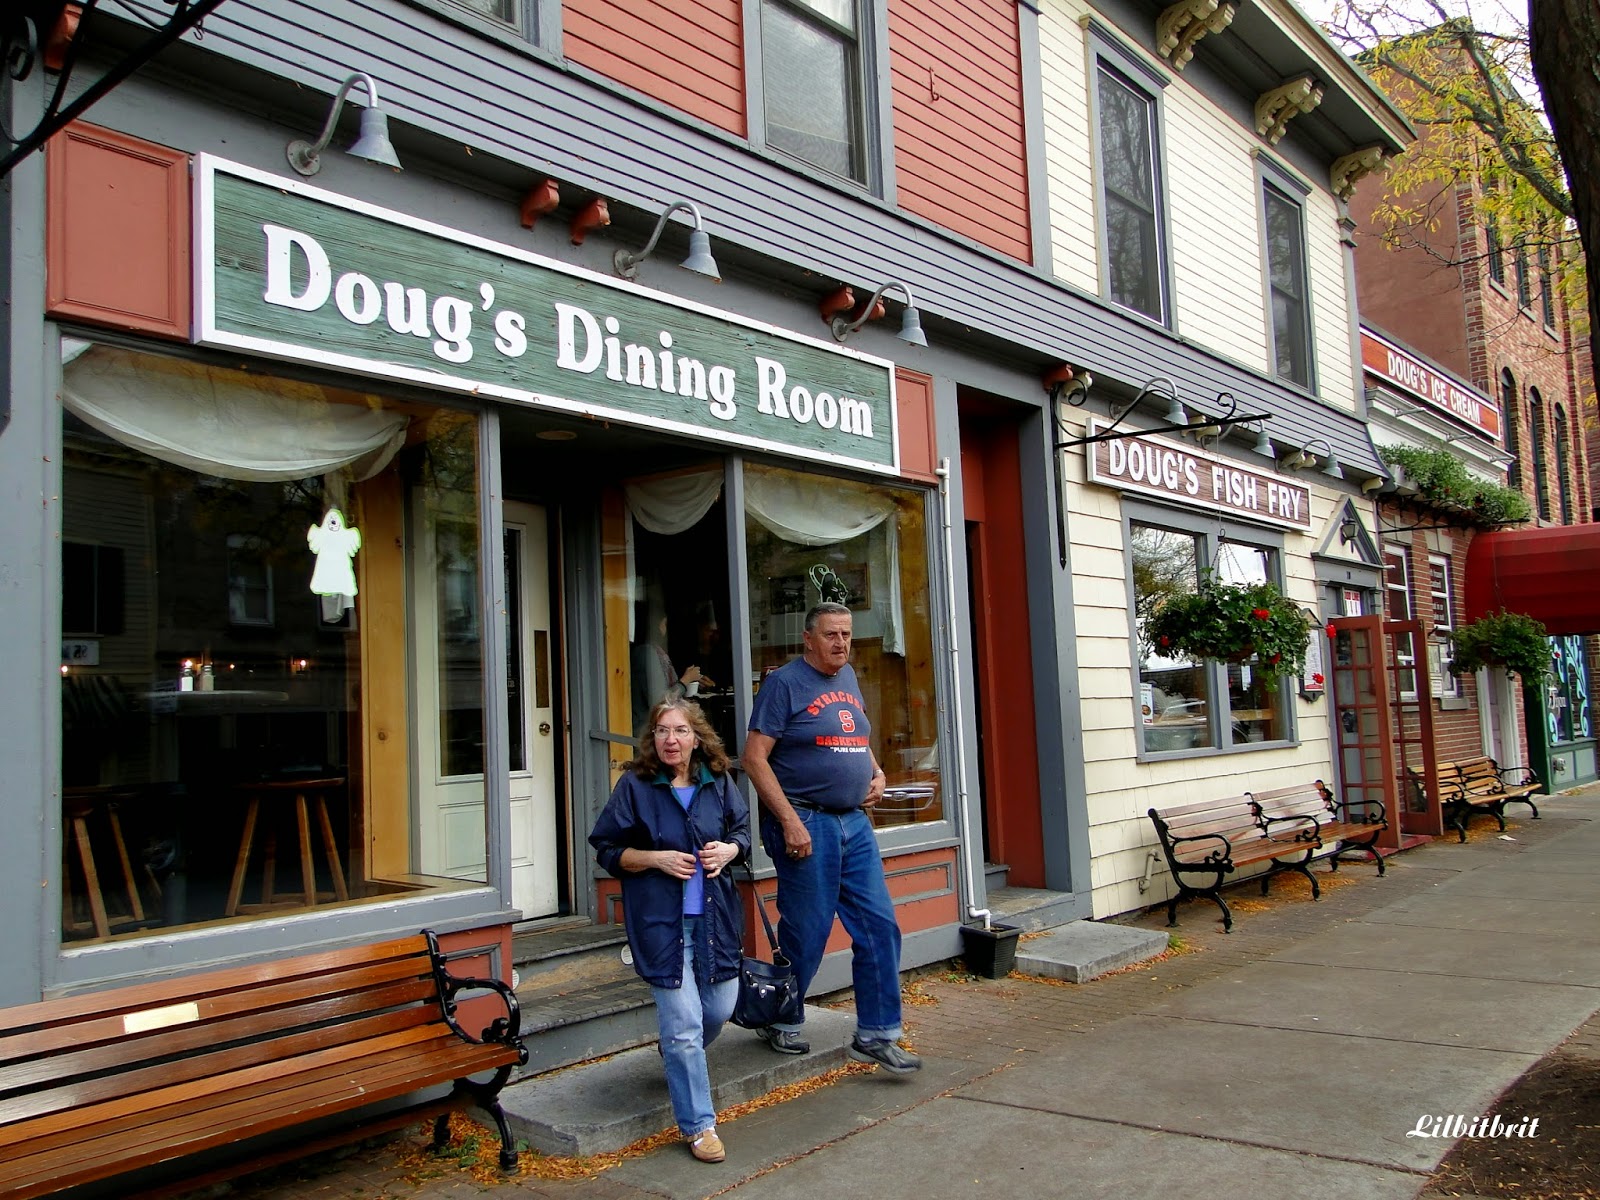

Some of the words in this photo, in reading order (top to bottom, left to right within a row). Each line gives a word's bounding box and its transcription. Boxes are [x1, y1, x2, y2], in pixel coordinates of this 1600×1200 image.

[263, 224, 527, 363] Doug's
[554, 302, 737, 421] Dining
[754, 356, 874, 438] Room
[1387, 350, 1428, 394] DOUG'S
[1430, 375, 1448, 406] ICE
[1449, 388, 1481, 425] CREAM
[1108, 438, 1200, 495] DOUG'S
[1211, 465, 1258, 510] FISH
[1267, 481, 1302, 521] FRY
[807, 690, 865, 716] SYRACUS
[838, 709, 856, 733] S
